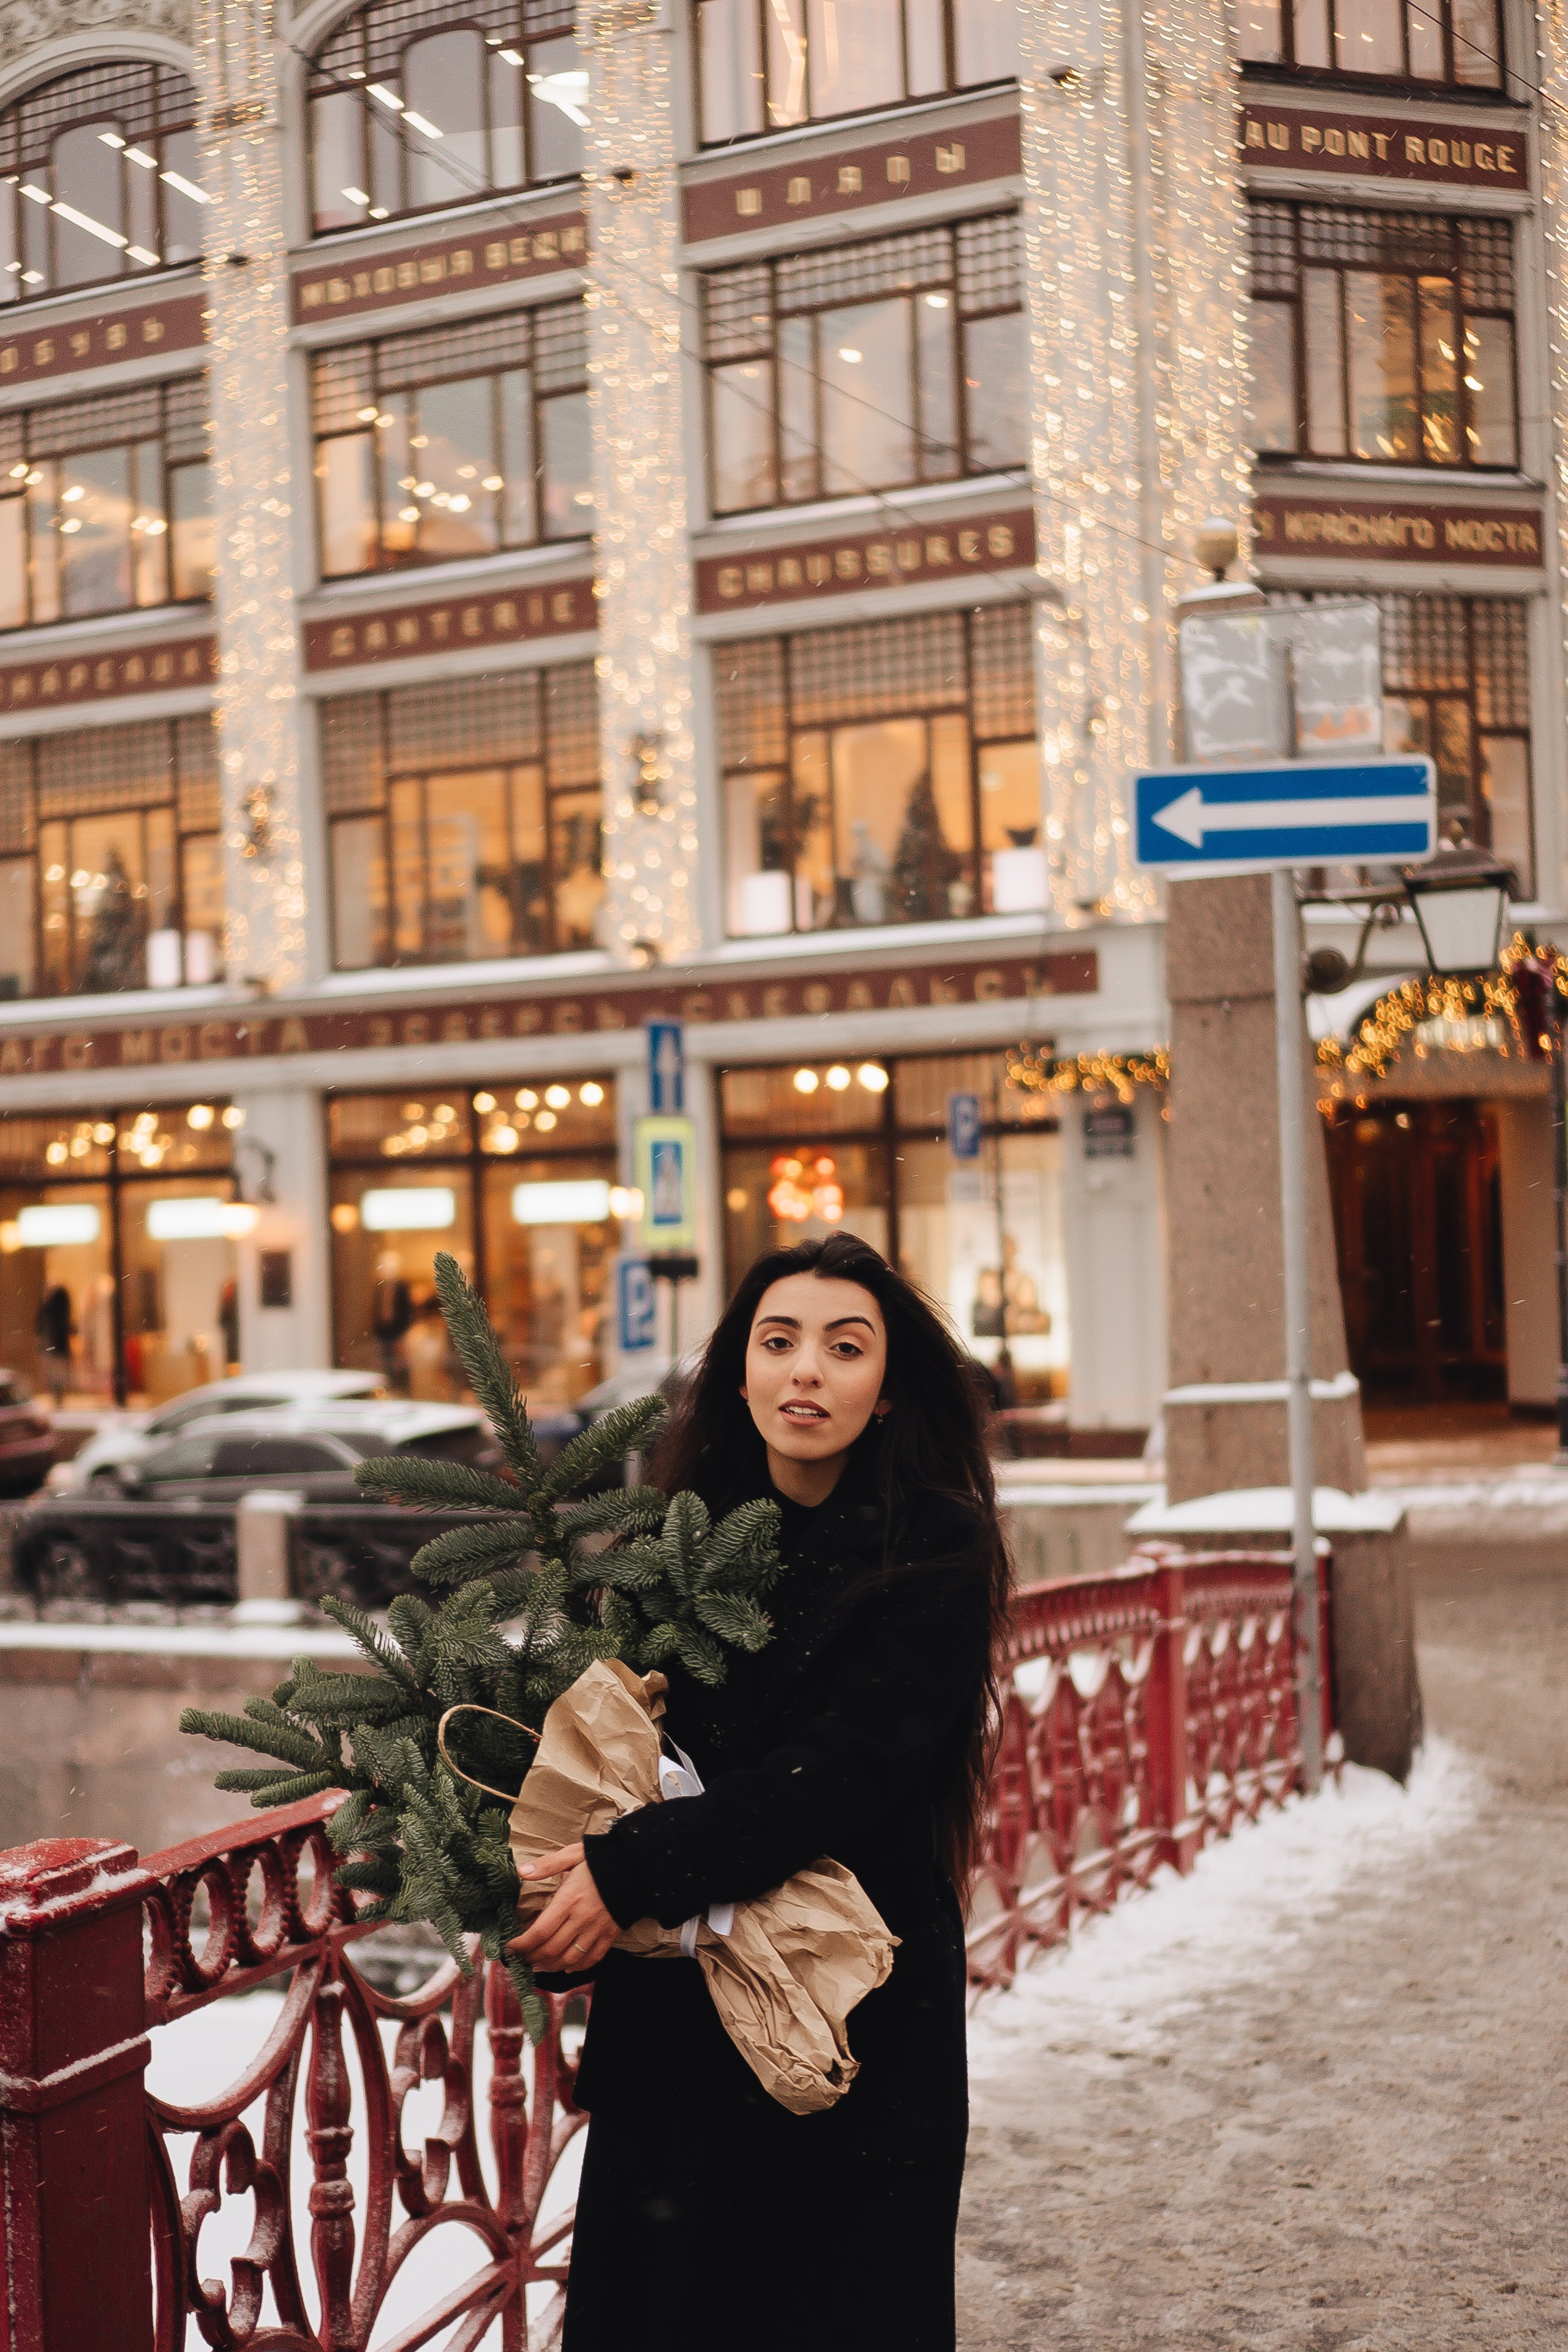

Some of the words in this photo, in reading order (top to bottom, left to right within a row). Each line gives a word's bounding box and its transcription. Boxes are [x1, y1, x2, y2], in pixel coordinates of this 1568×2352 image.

[1245, 120, 1289, 151] AU
[1300, 125, 1390, 161] PONT
[1404, 135, 1518, 174] ROUGE
[717, 525, 1015, 599] CHAUSSURES
[330, 591, 575, 658] GANTERIE
[0, 647, 201, 706] HAPEAUX
